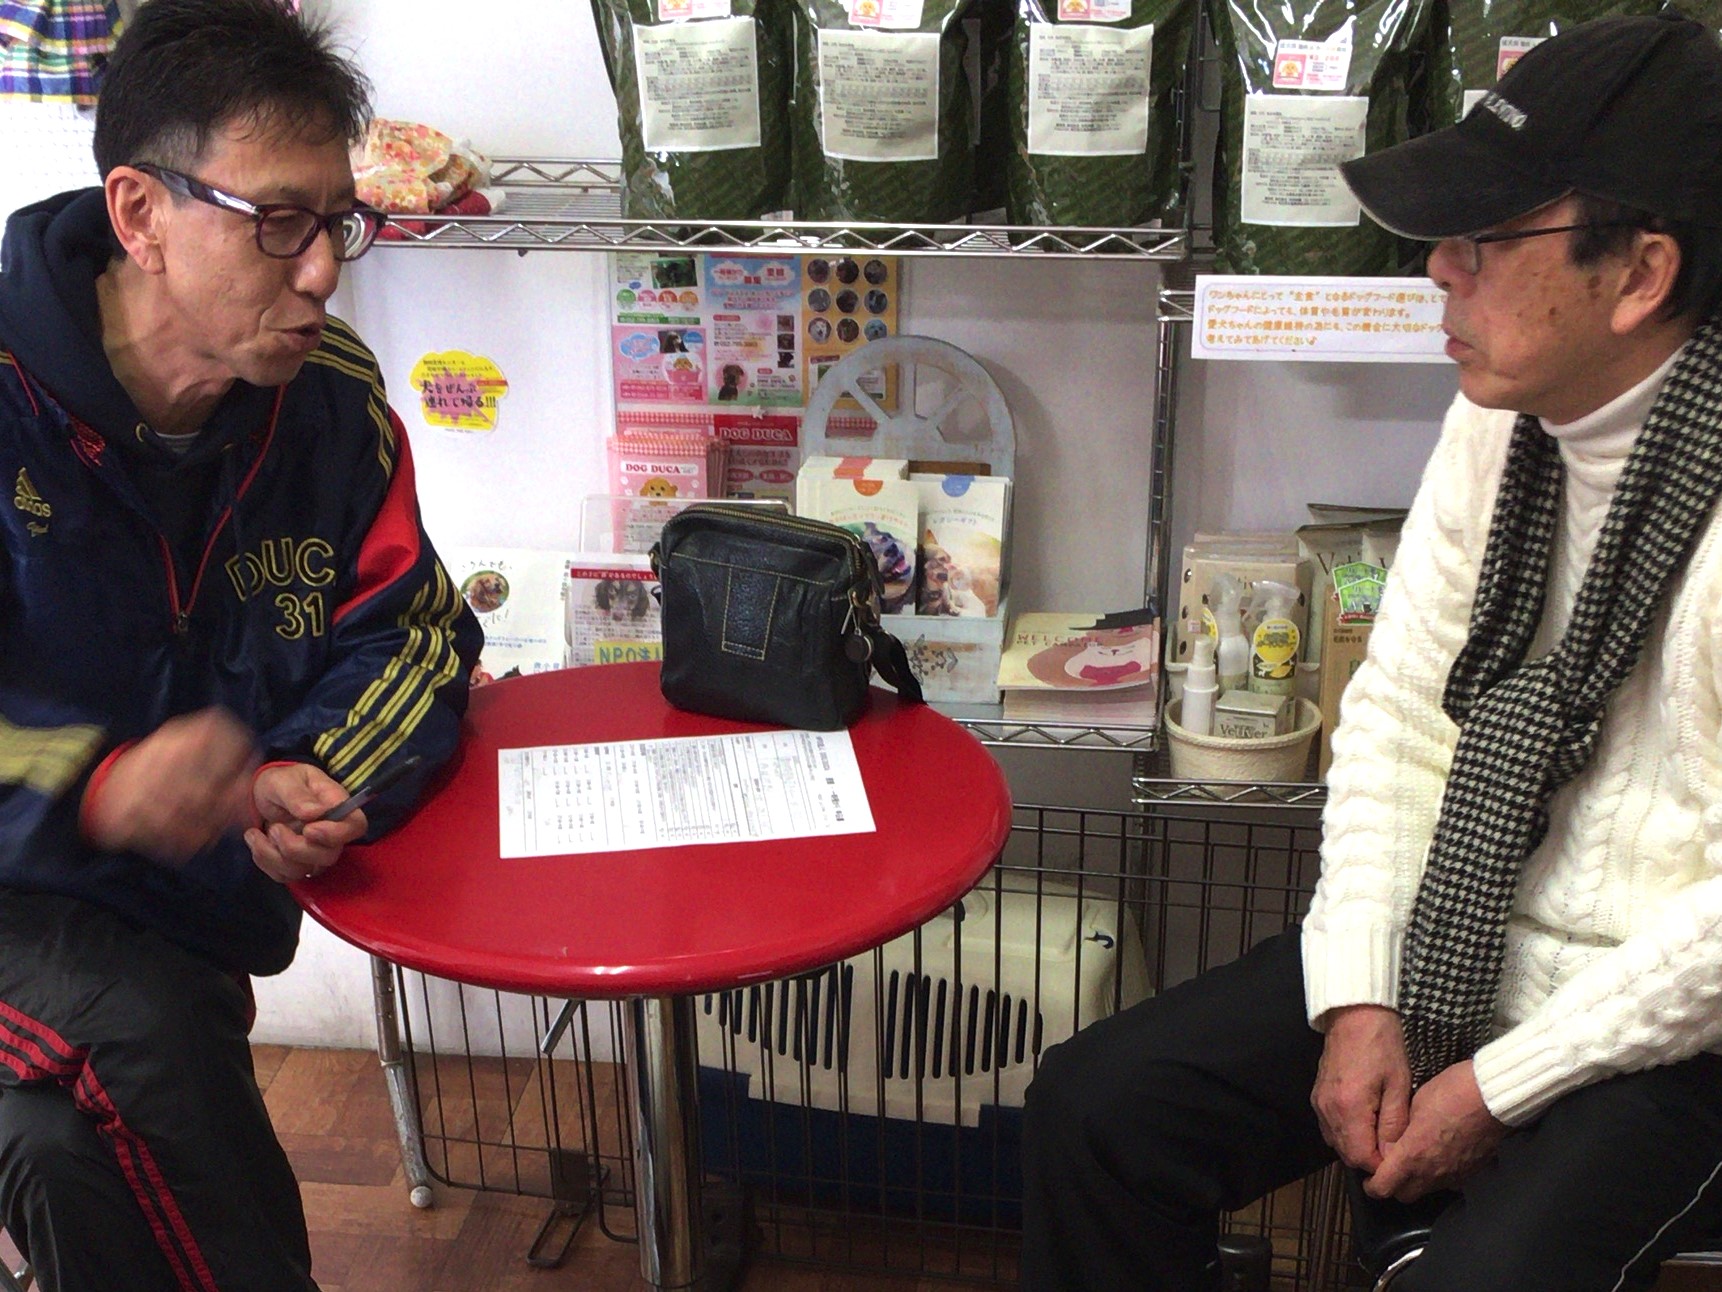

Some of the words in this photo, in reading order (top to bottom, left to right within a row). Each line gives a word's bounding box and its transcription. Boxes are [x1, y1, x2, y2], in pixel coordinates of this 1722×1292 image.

[719, 427, 750, 440] DOG
[752, 428, 793, 441] DUCA
[625, 463, 648, 473] DOG
[651, 464, 680, 475] DUCA
[224, 537, 336, 602] DUC
[275, 592, 325, 640] 31
